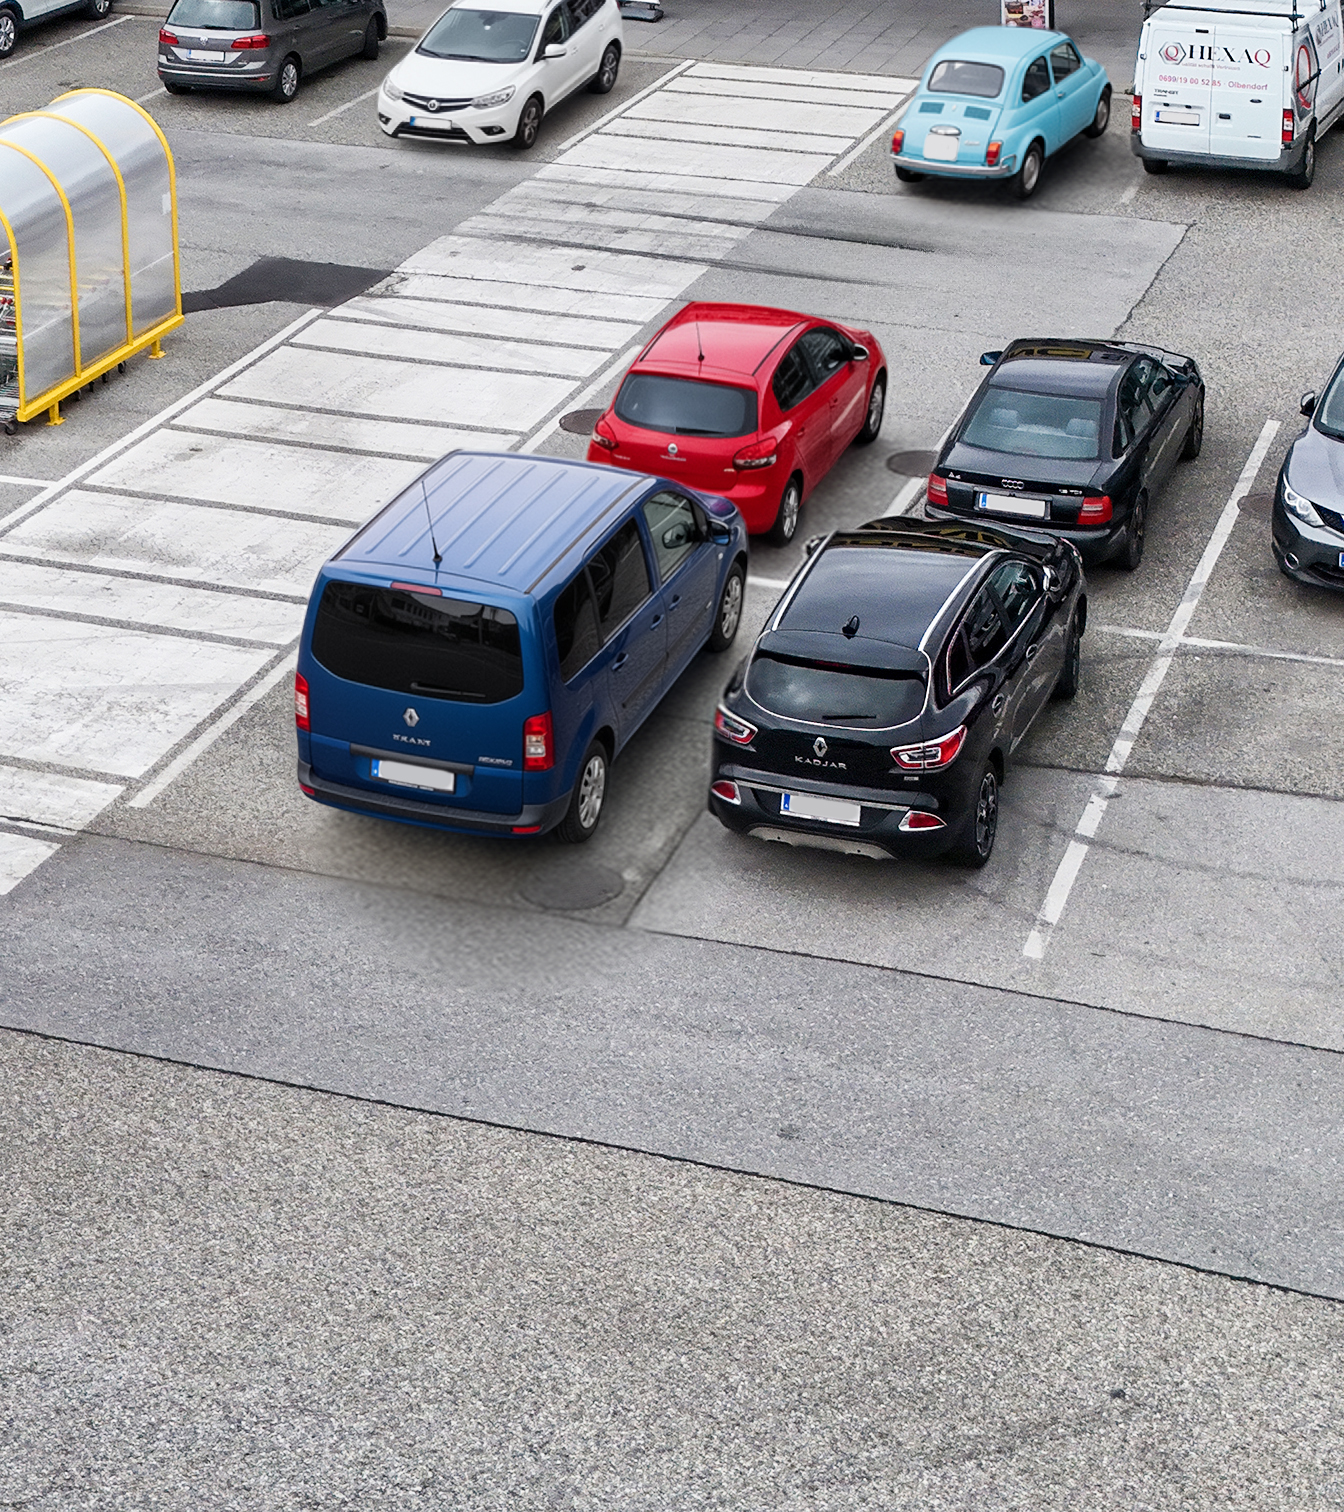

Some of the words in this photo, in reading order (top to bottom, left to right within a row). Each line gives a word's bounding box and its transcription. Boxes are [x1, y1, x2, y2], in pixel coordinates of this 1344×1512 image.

[1188, 44, 1271, 69] HEXAQ
[1228, 80, 1268, 91] Olbendorf
[794, 755, 847, 770] KADJAR
